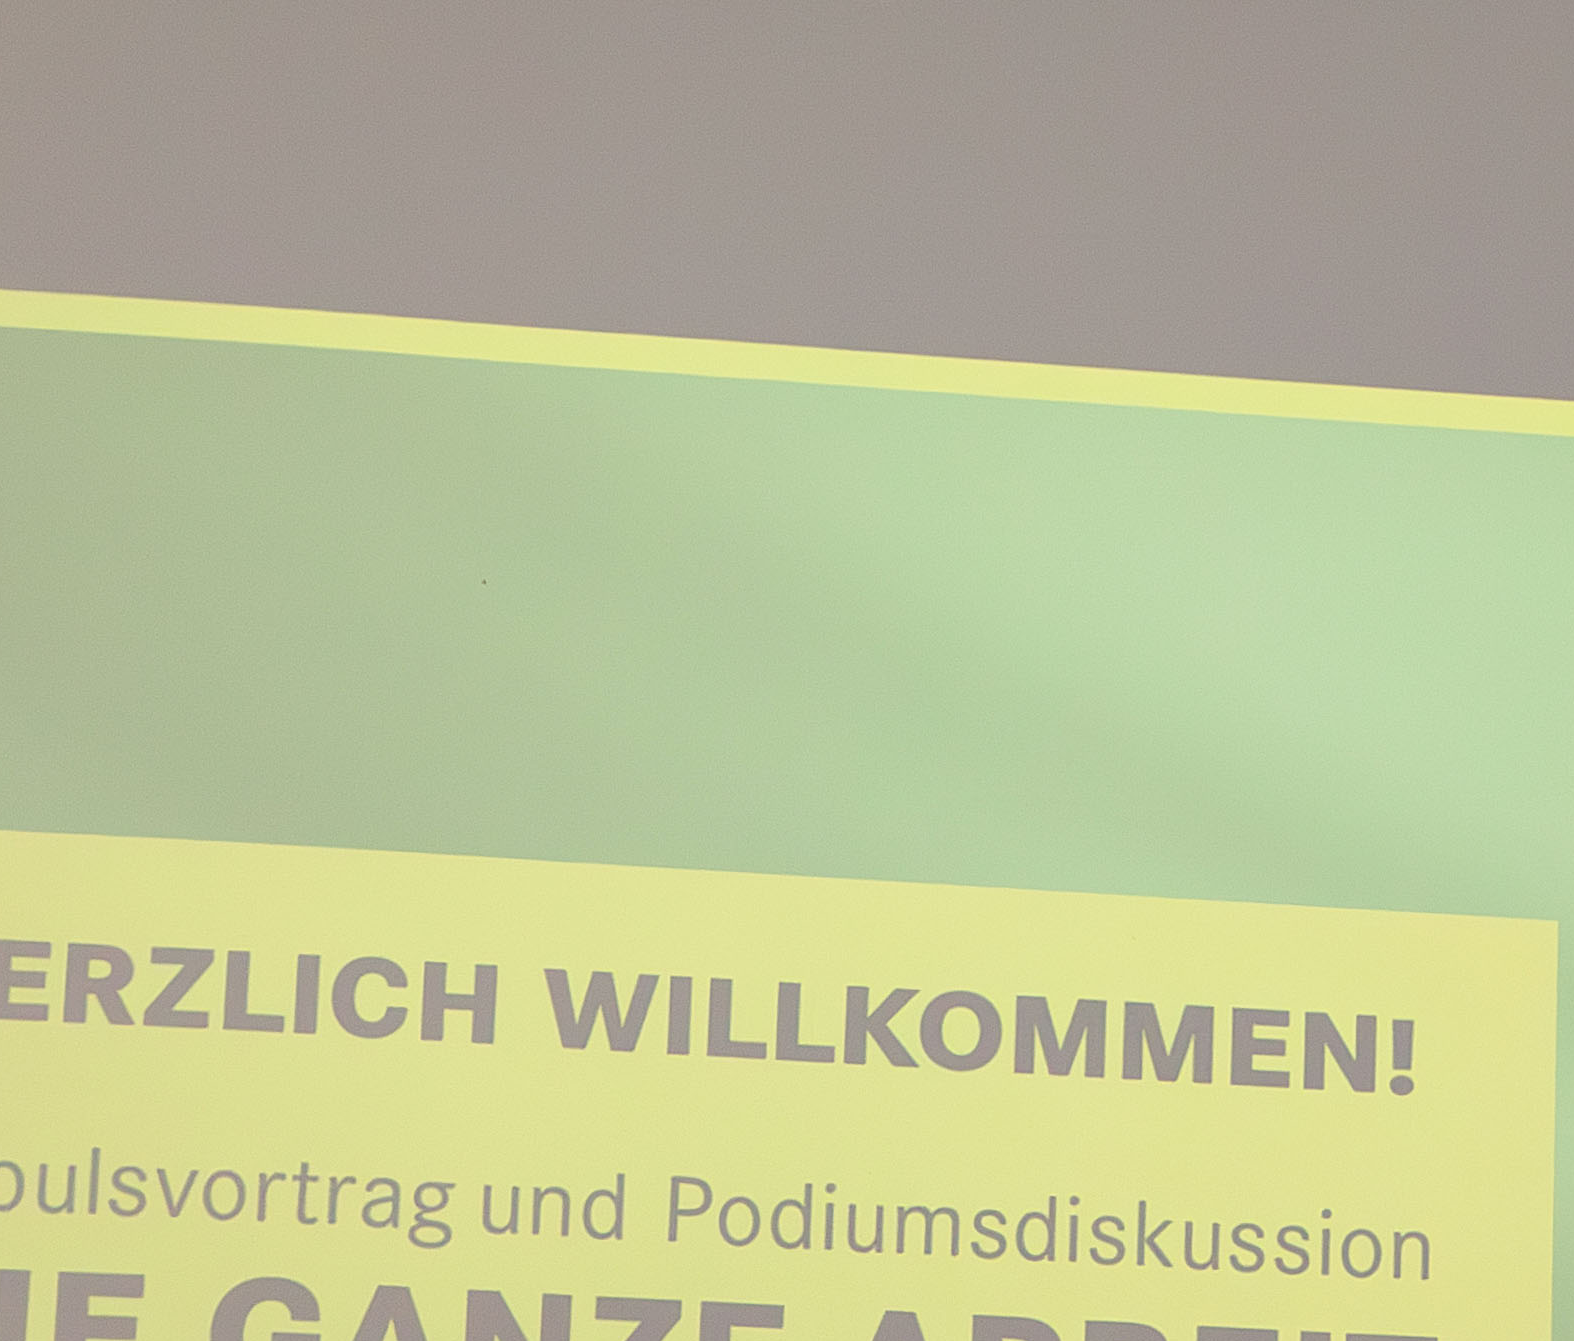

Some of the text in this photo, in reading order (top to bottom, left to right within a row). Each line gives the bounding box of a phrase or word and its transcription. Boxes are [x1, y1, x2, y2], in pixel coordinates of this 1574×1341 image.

[543, 968, 1416, 1096] WILLKOMMEN!
[481, 1172, 626, 1241] und
[666, 1175, 1431, 1281] Podiumsdiskussion
